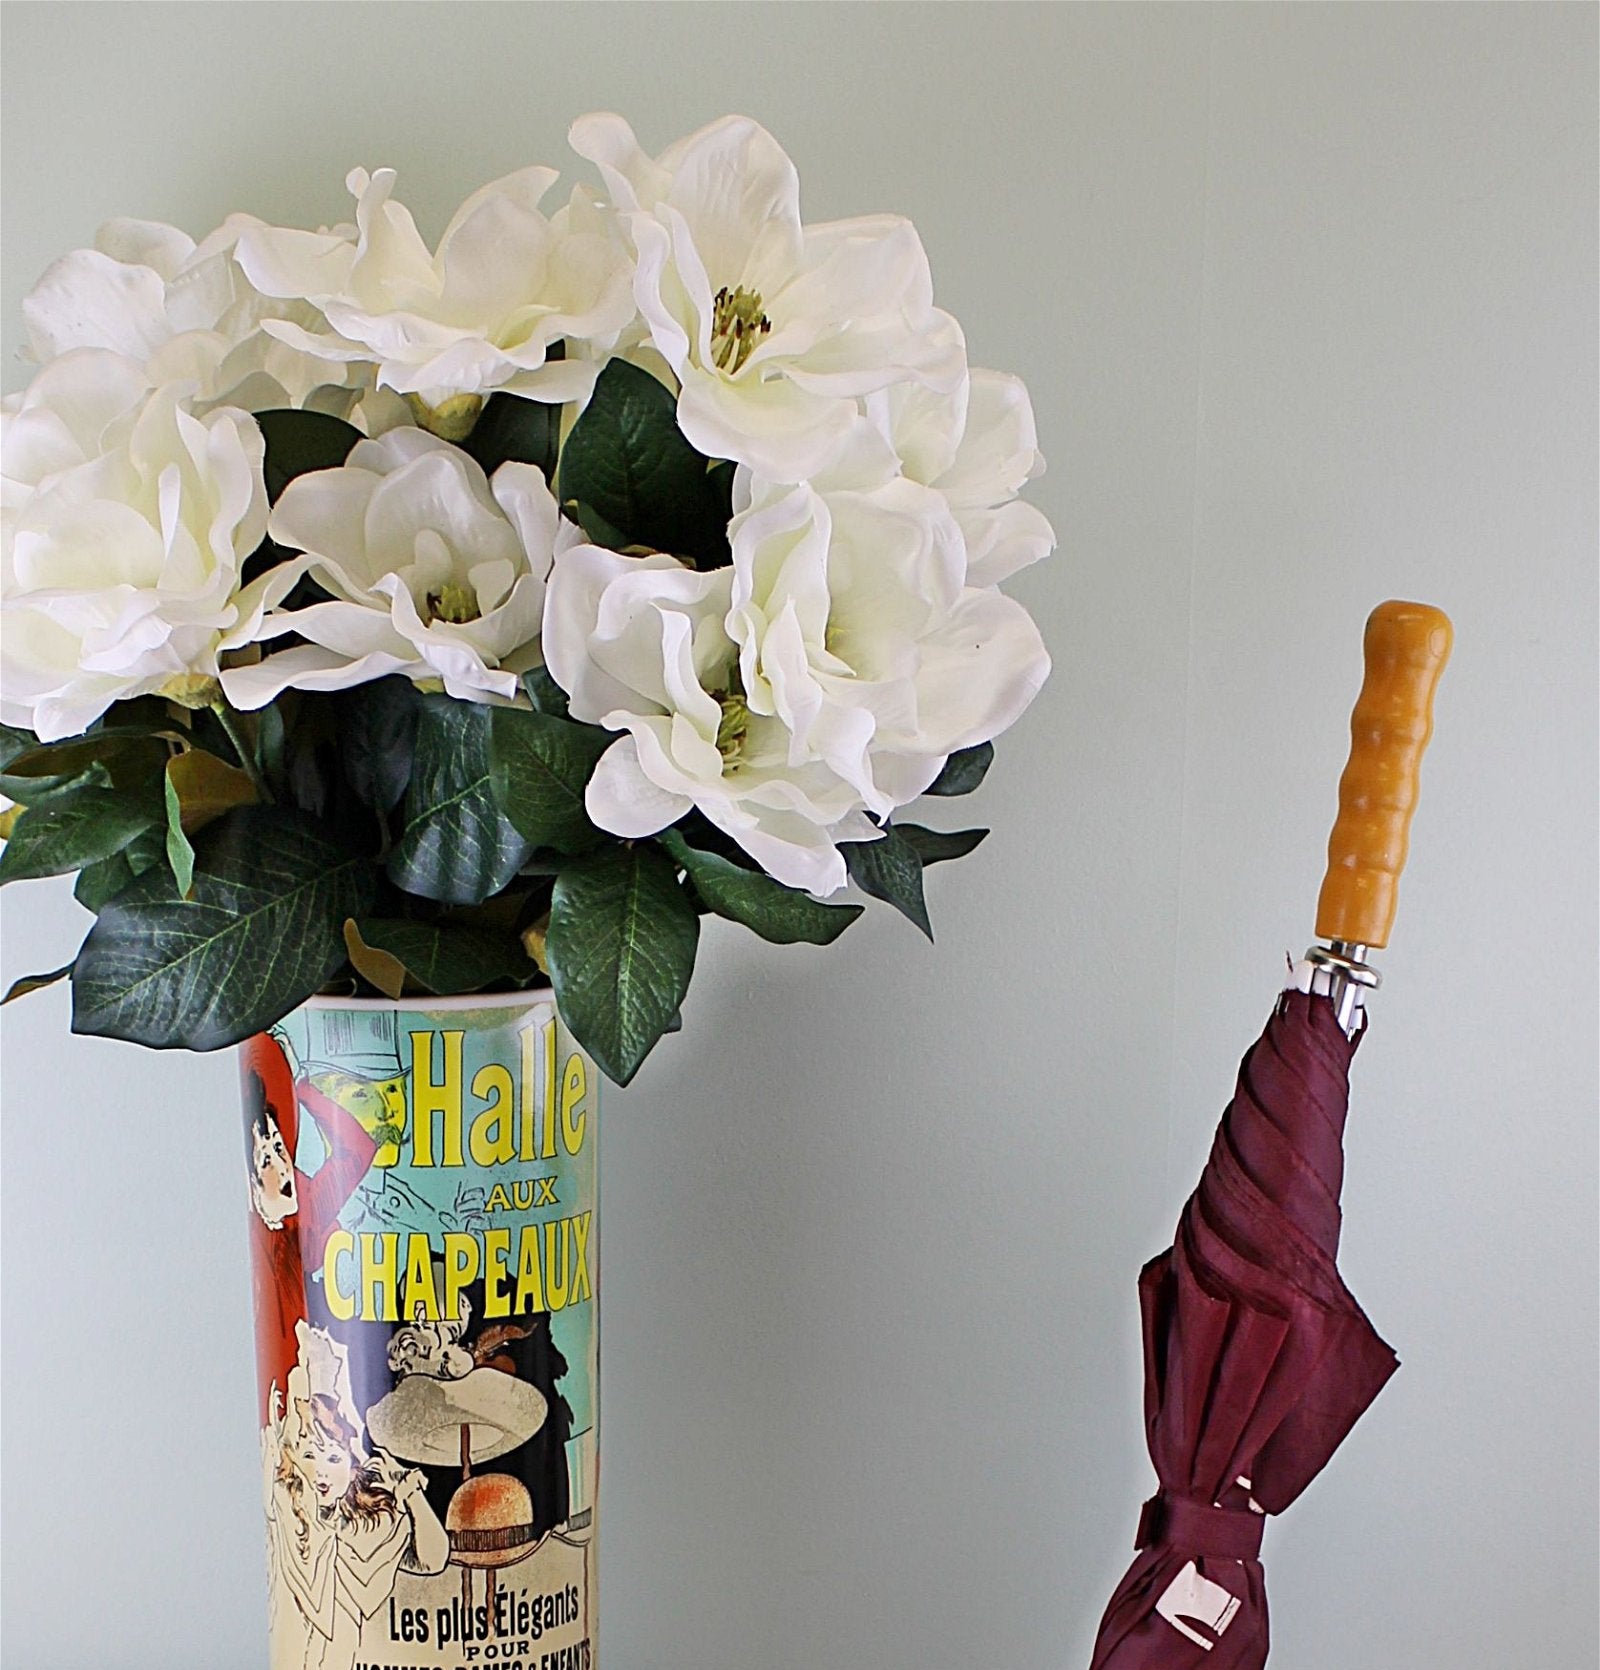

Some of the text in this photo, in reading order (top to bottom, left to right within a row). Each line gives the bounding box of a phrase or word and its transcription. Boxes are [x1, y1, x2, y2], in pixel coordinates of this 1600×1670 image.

[409, 1016, 587, 1168] Halle
[483, 1175, 560, 1213] AUX
[323, 1210, 592, 1322] CHAPEAUX
[390, 1583, 579, 1650] Les plus Élégants
[466, 1640, 530, 1661] POUR
